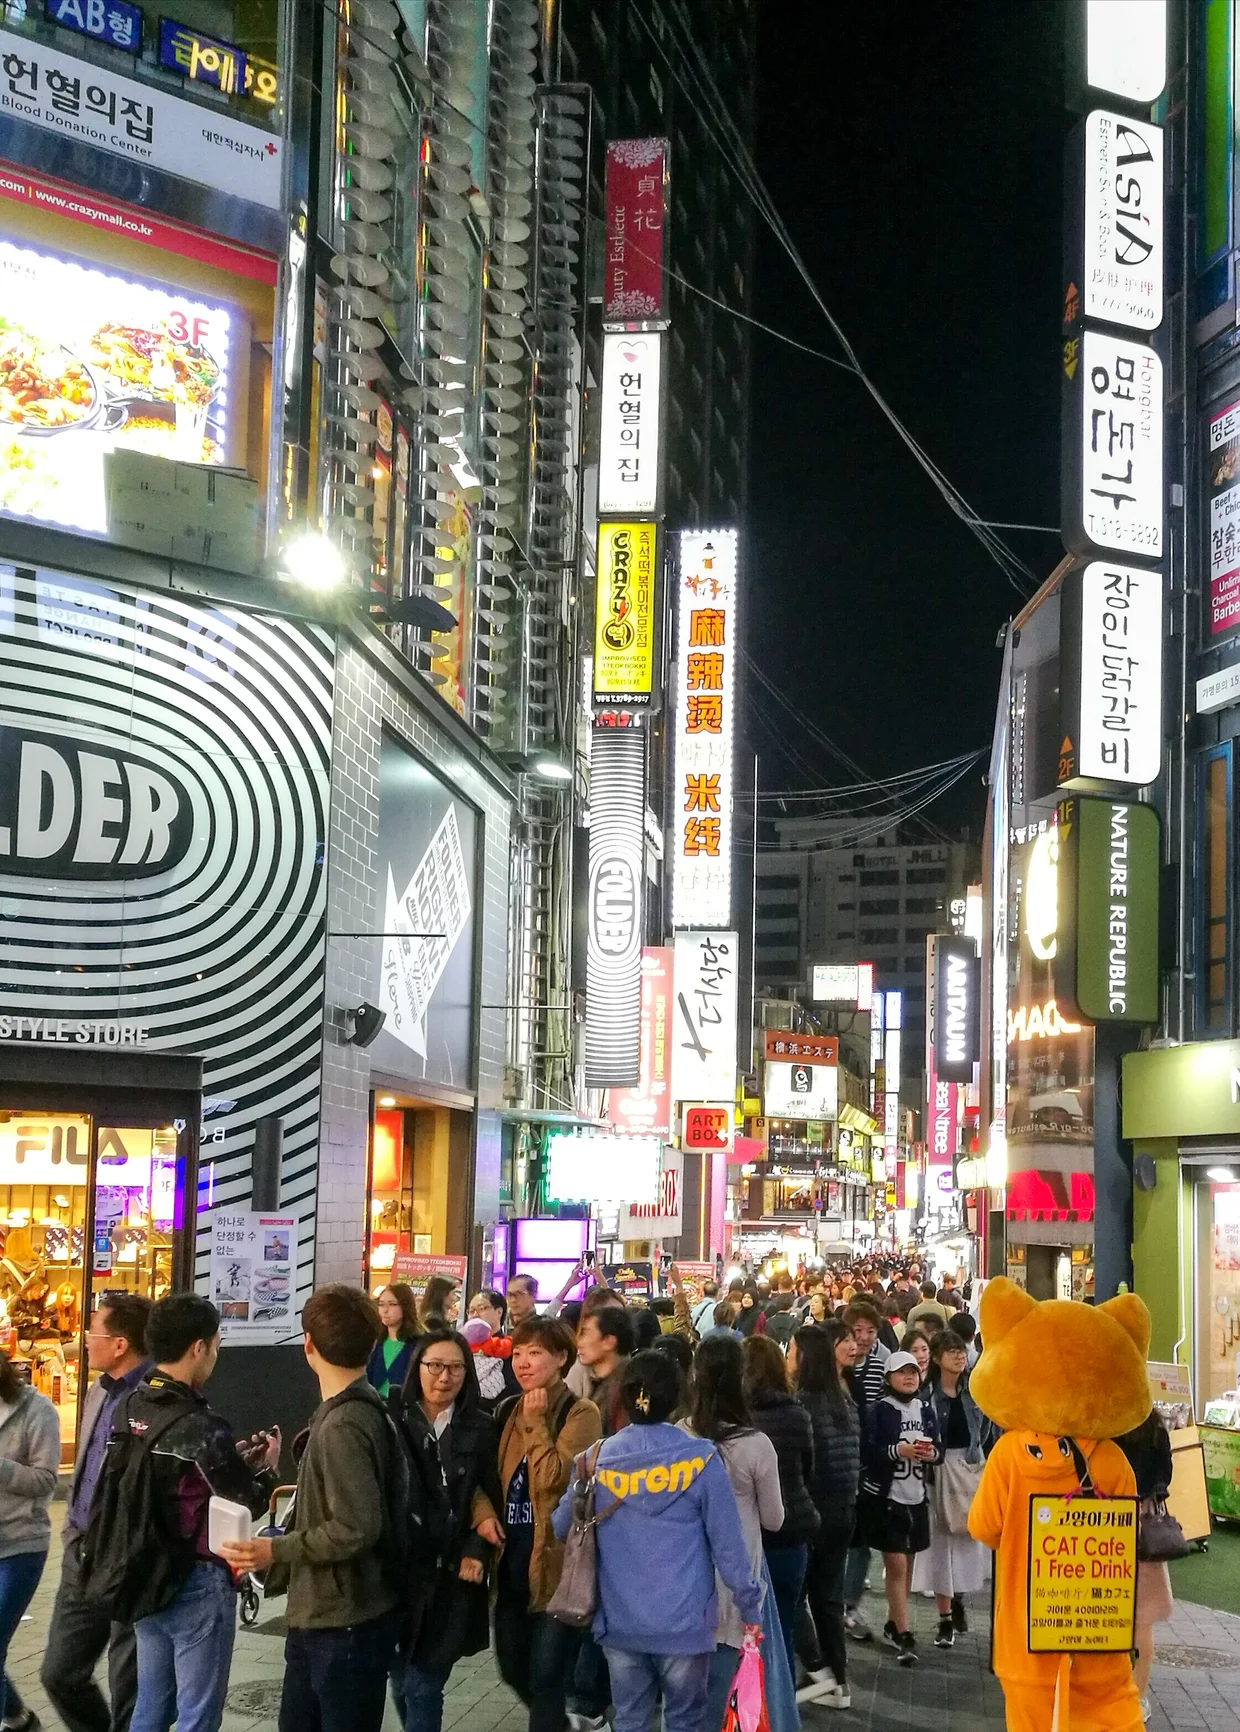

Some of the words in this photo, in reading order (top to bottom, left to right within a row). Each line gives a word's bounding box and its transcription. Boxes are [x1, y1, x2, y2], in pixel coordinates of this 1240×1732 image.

[1, 52, 154, 144] 헌혈의집
[45, 110, 106, 142] Donation
[110, 135, 153, 158] Center
[202, 128, 264, 161] 대한적십자사
[35, 189, 153, 236] www.crazymall.co.kr
[167, 310, 210, 346] 3F
[617, 371, 643, 484] 헌혈의집
[1215, 493, 1231, 510] Beef
[637, 531, 650, 648] 즉석떡볶이전문점
[1212, 585, 1239, 608] Charcoal
[685, 608, 726, 734] 麻辣烫
[1101, 572, 1140, 774] 장인닭갈비
[1202, 680, 1228, 698] 가맹문의
[1058, 757, 1075, 778] 2F
[684, 774, 721, 857] 米线
[1059, 800, 1074, 822] 1F
[1110, 806, 1128, 897] NATURE
[438, 825, 461, 934] FOLDER
[596, 861, 633, 953] FOLDER
[1109, 905, 1127, 1014] REPUBLIC
[75, 1021, 149, 1047] STORE
[775, 1041, 834, 1059] 横浜エステ
[692, 1114, 725, 1127] ART
[15, 1126, 128, 1166] FILA
[216, 1231, 245, 1242] 단정할
[247, 1231, 256, 1242] 수
[217, 1216, 245, 1227] 하나로
[216, 1245, 235, 1256] 없는
[1055, 1510, 1133, 1527] 고양이카페
[1042, 1536, 1078, 1555] CAT
[1084, 1537, 1125, 1556] Cafe
[1035, 1559, 1041, 1578] 1
[1049, 1559, 1086, 1579] Free
[1092, 1559, 1133, 1579] Drink
